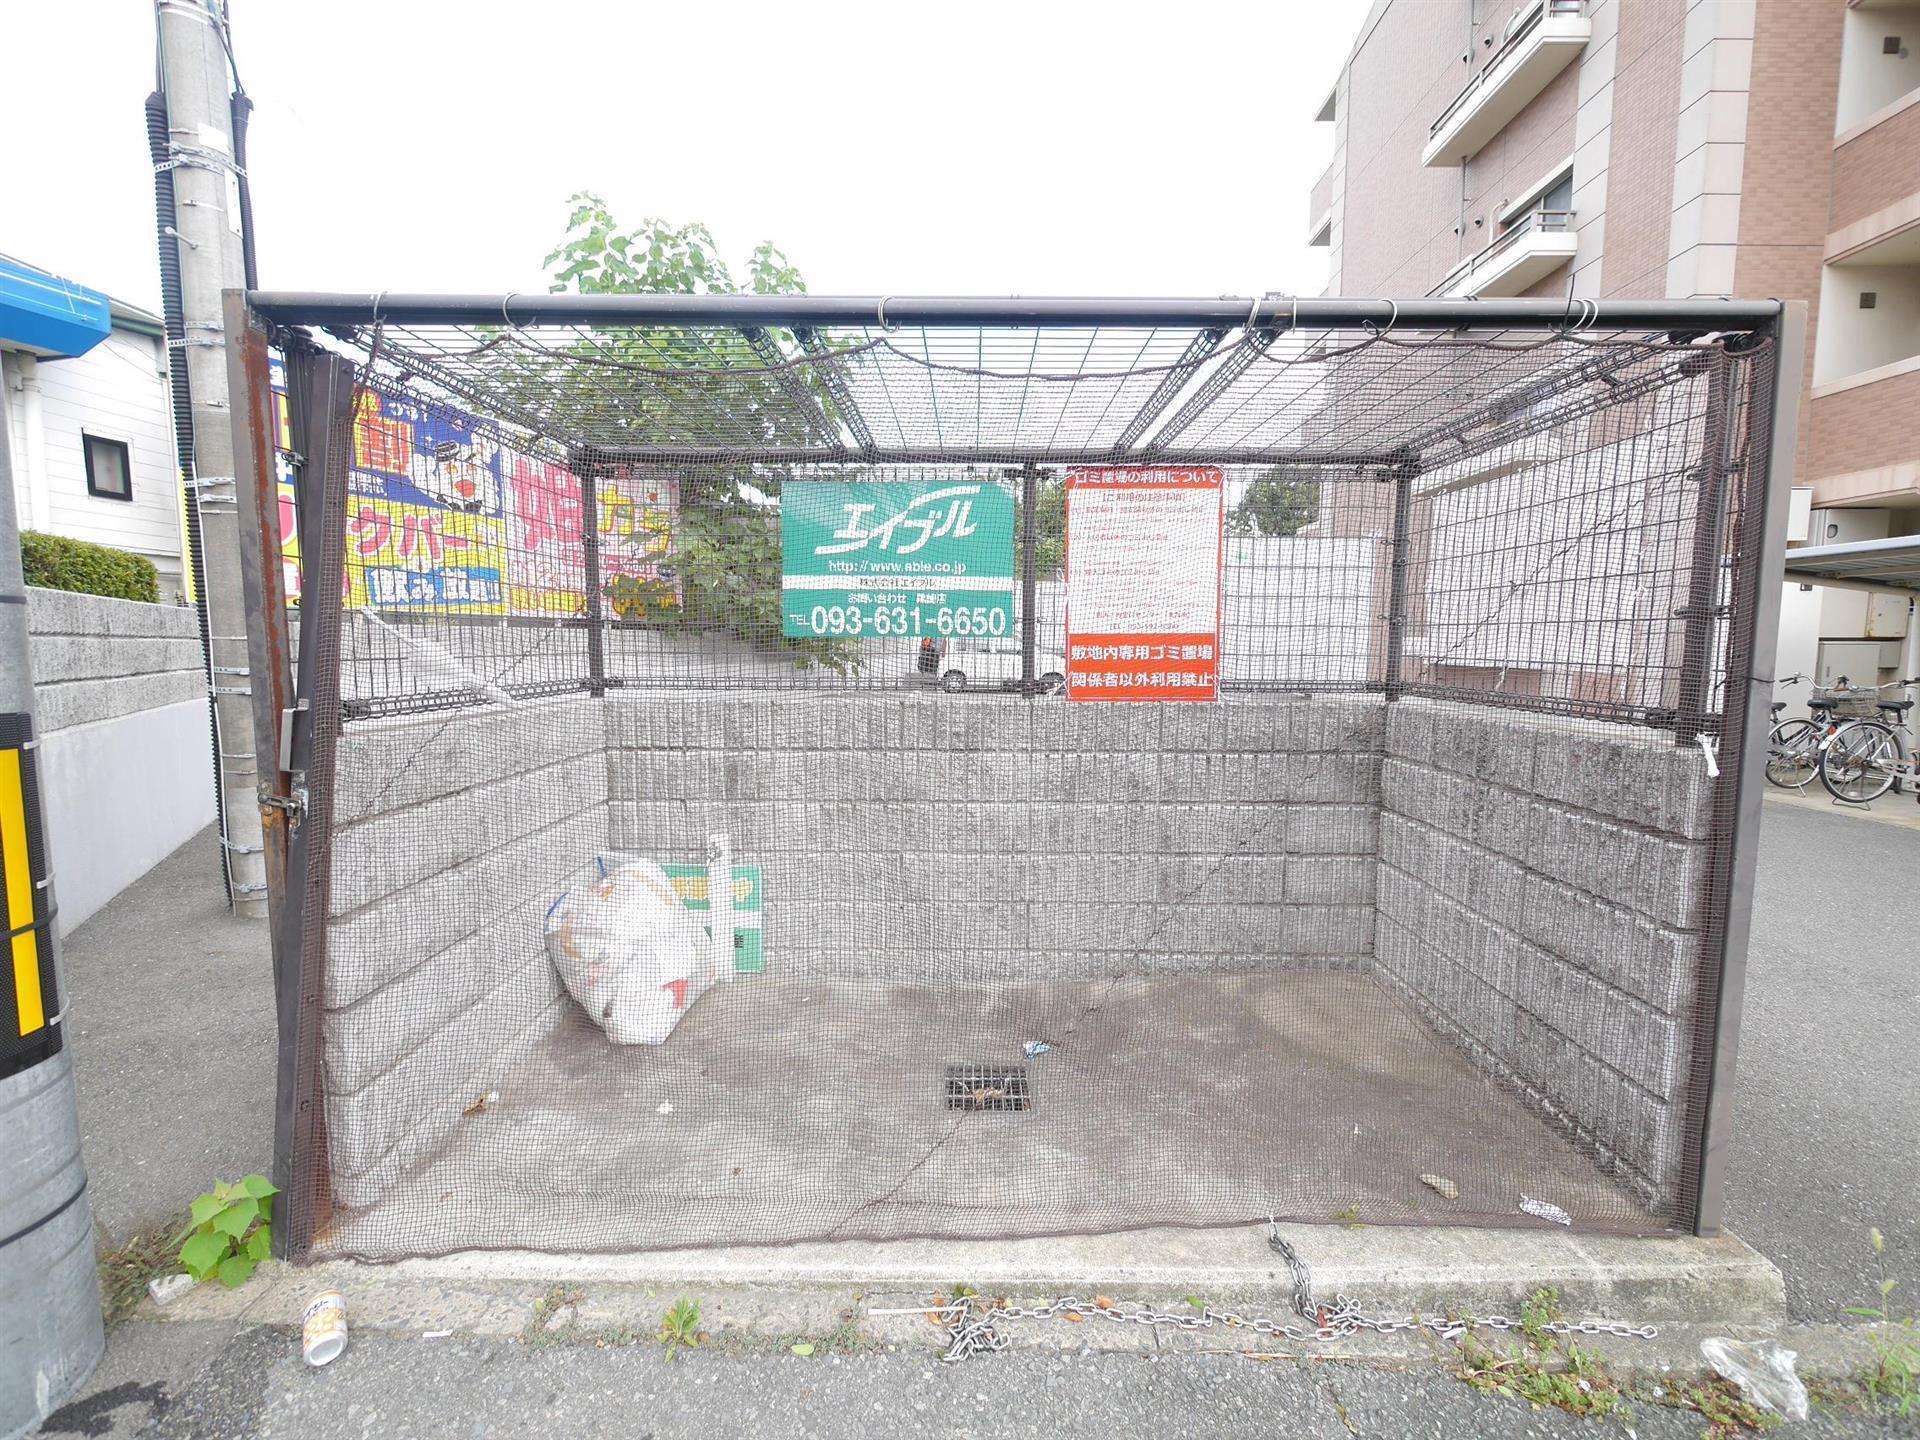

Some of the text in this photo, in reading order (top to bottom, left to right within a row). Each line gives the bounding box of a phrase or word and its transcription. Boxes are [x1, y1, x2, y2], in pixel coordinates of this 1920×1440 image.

[1074, 470, 1219, 485] ゴミ置場の利用について
[814, 485, 982, 555] エイブル
[789, 606, 1006, 635] TEL 093-631-6650
[1071, 645, 1213, 661] 敷地内専用ゴミ置場
[1071, 672, 1212, 688] 関係者以外利用禁止
